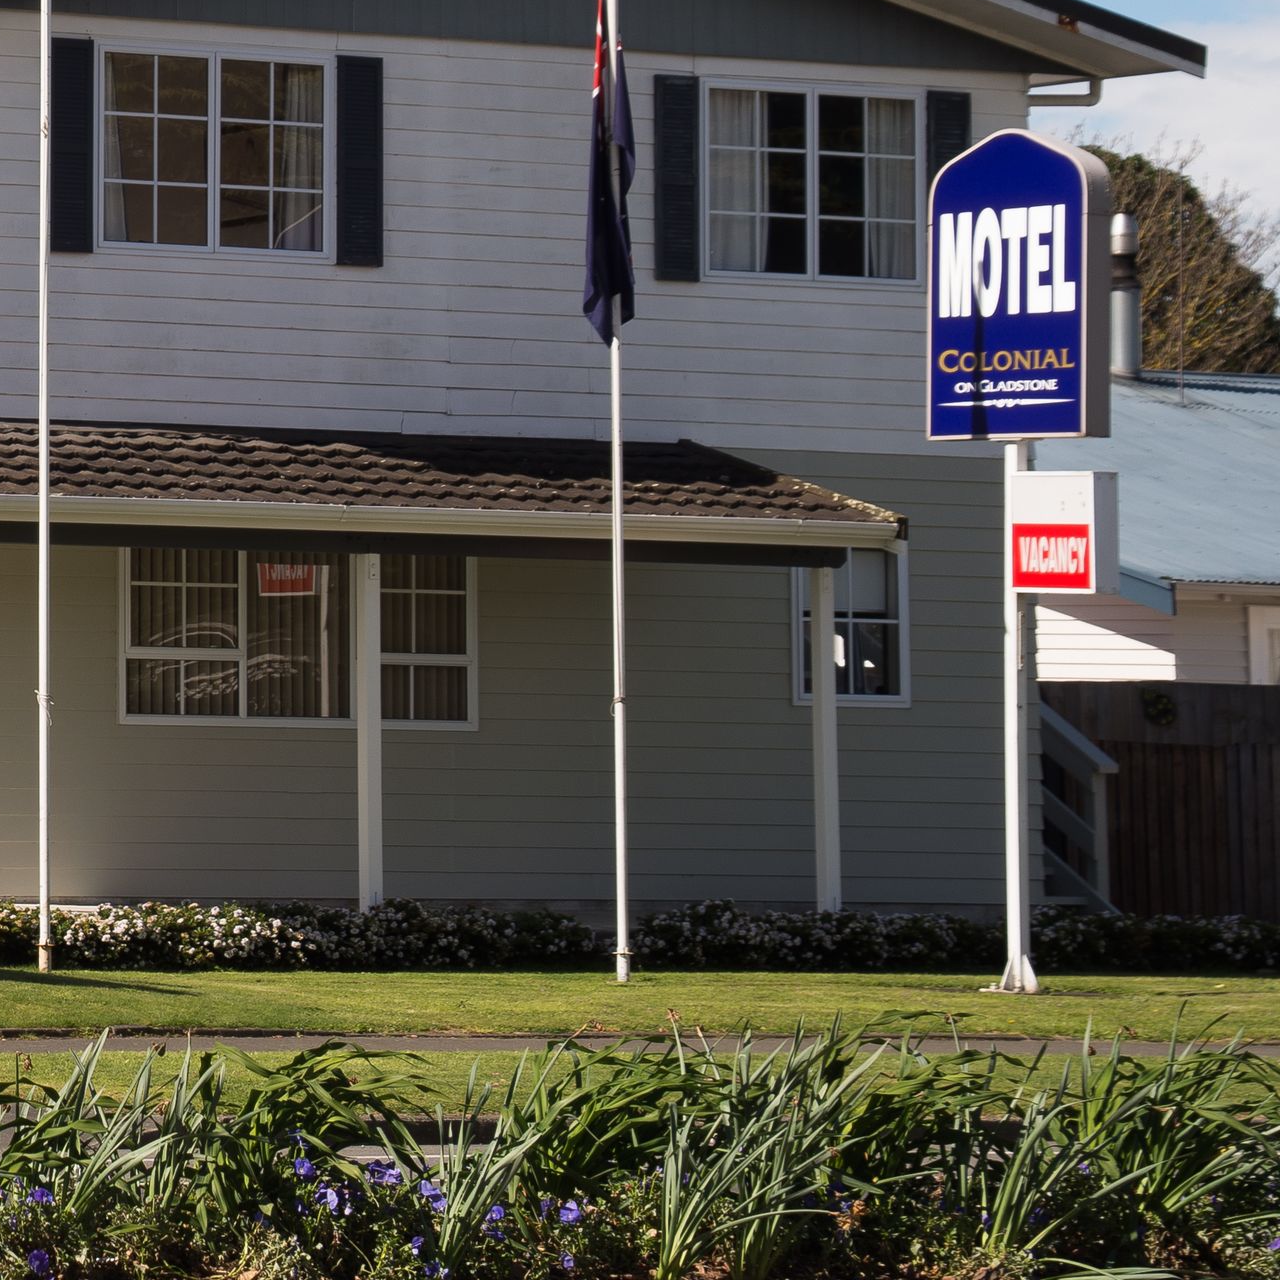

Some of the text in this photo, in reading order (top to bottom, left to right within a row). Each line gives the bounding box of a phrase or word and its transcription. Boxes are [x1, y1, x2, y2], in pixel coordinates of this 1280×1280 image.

[939, 203, 1076, 318] MOTEL
[938, 348, 1075, 373] COLONIAL
[954, 379, 1059, 394] ON GLADSTONE
[1018, 536, 1088, 574] VACANCY
